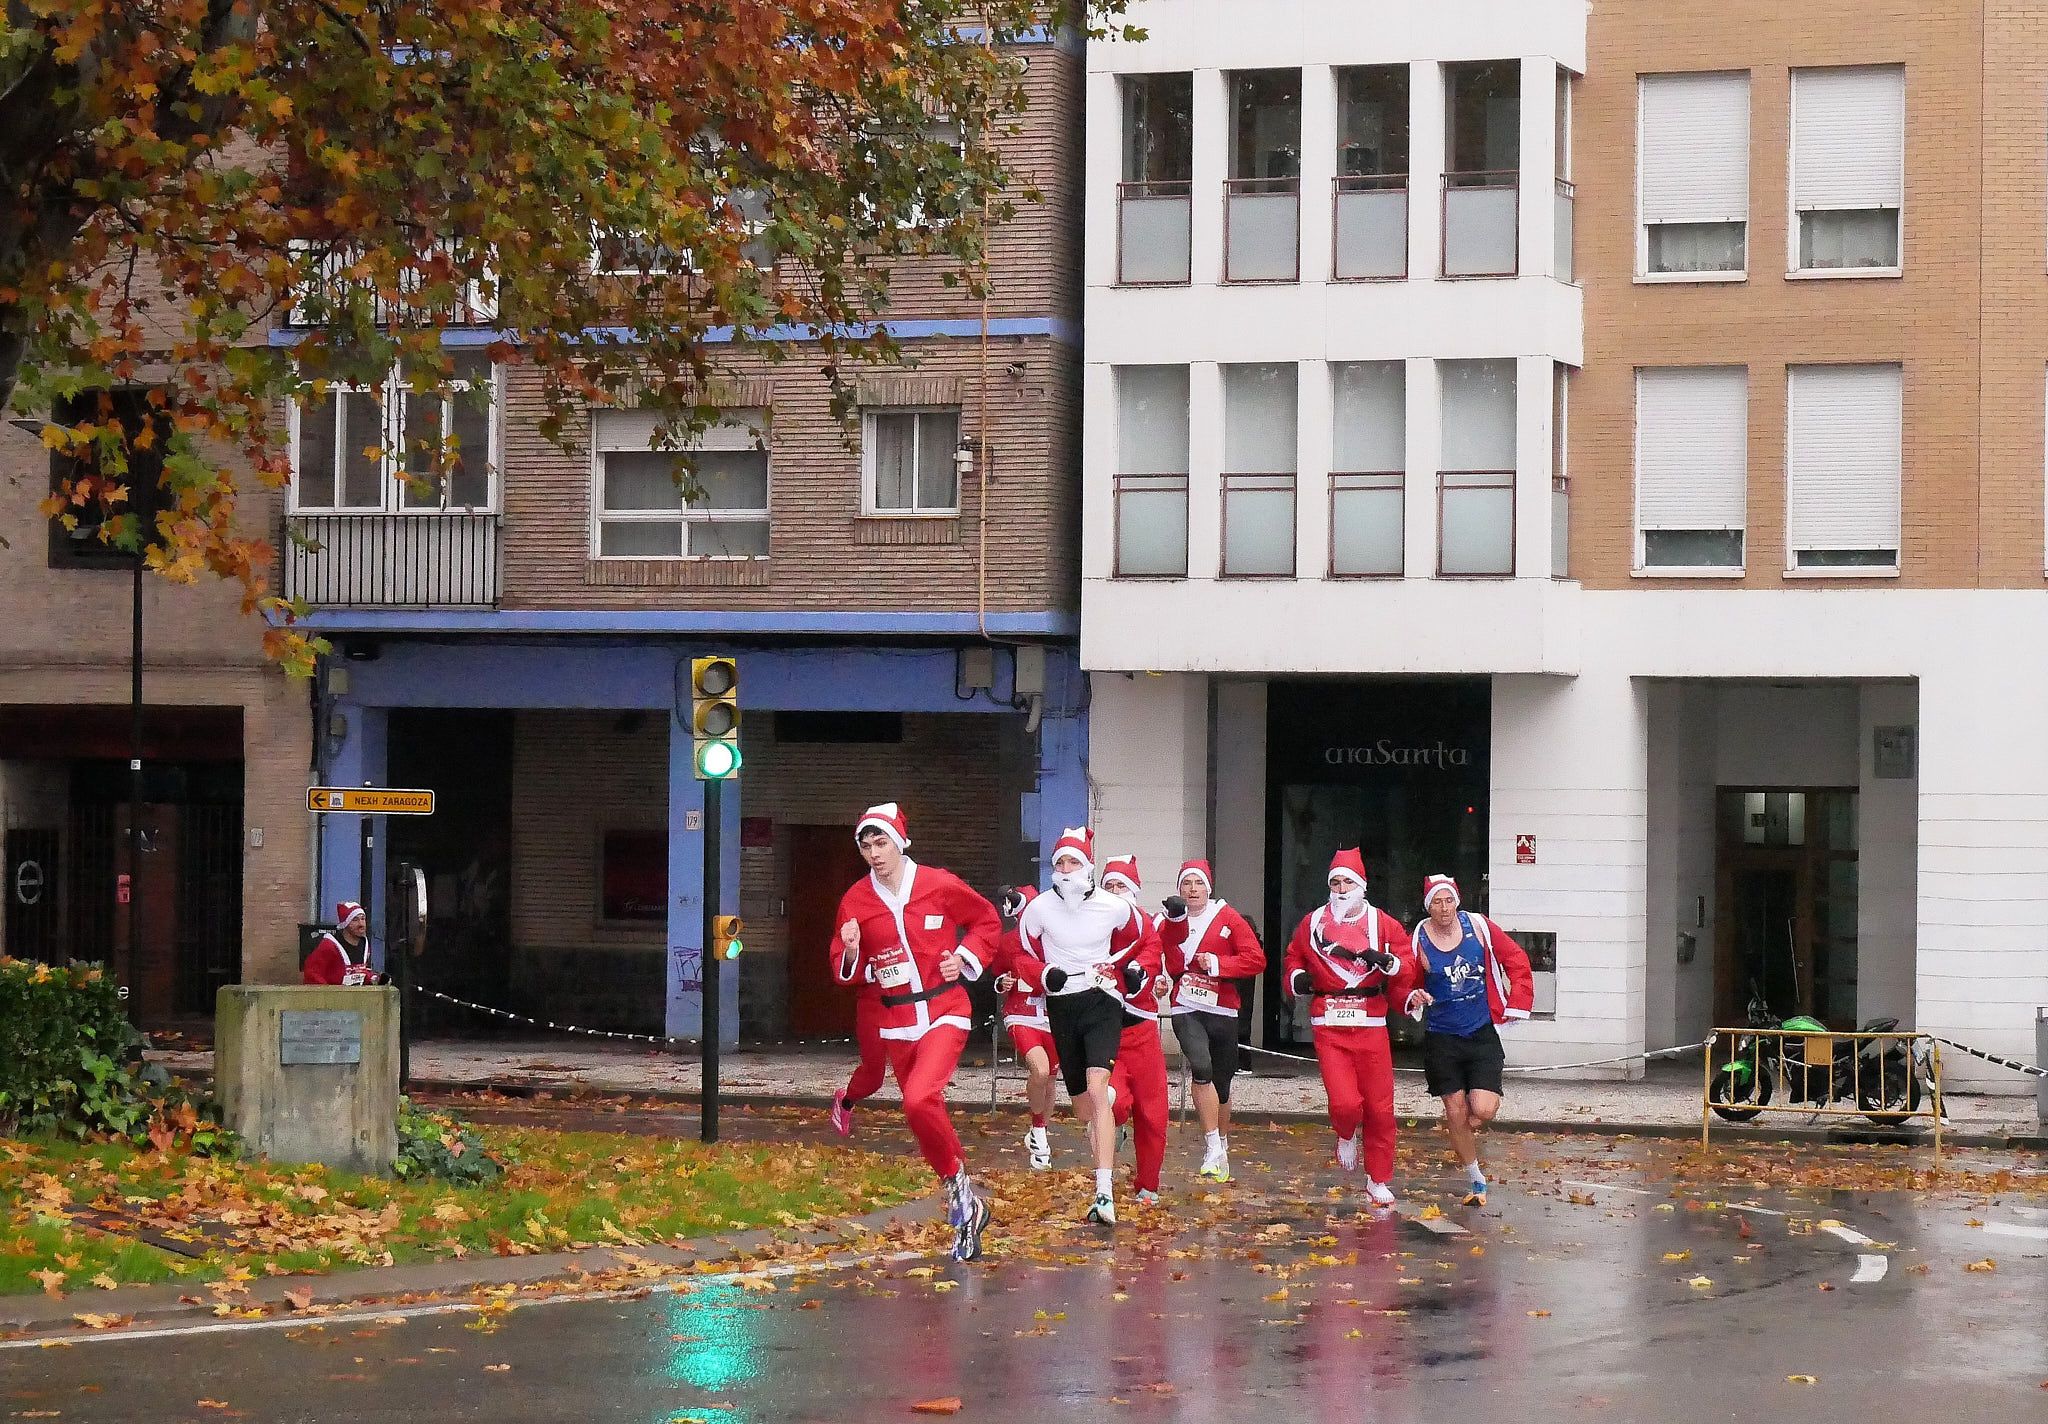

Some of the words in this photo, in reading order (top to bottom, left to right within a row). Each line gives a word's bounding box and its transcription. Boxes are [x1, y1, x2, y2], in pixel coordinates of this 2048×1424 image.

[354, 796, 378, 805] NEXH
[382, 797, 429, 807] ZARAGOZA
[687, 815, 698, 827] 179
[880, 966, 900, 979] 2916
[1190, 987, 1208, 998] 1454
[1336, 1010, 1356, 1018] 2224
